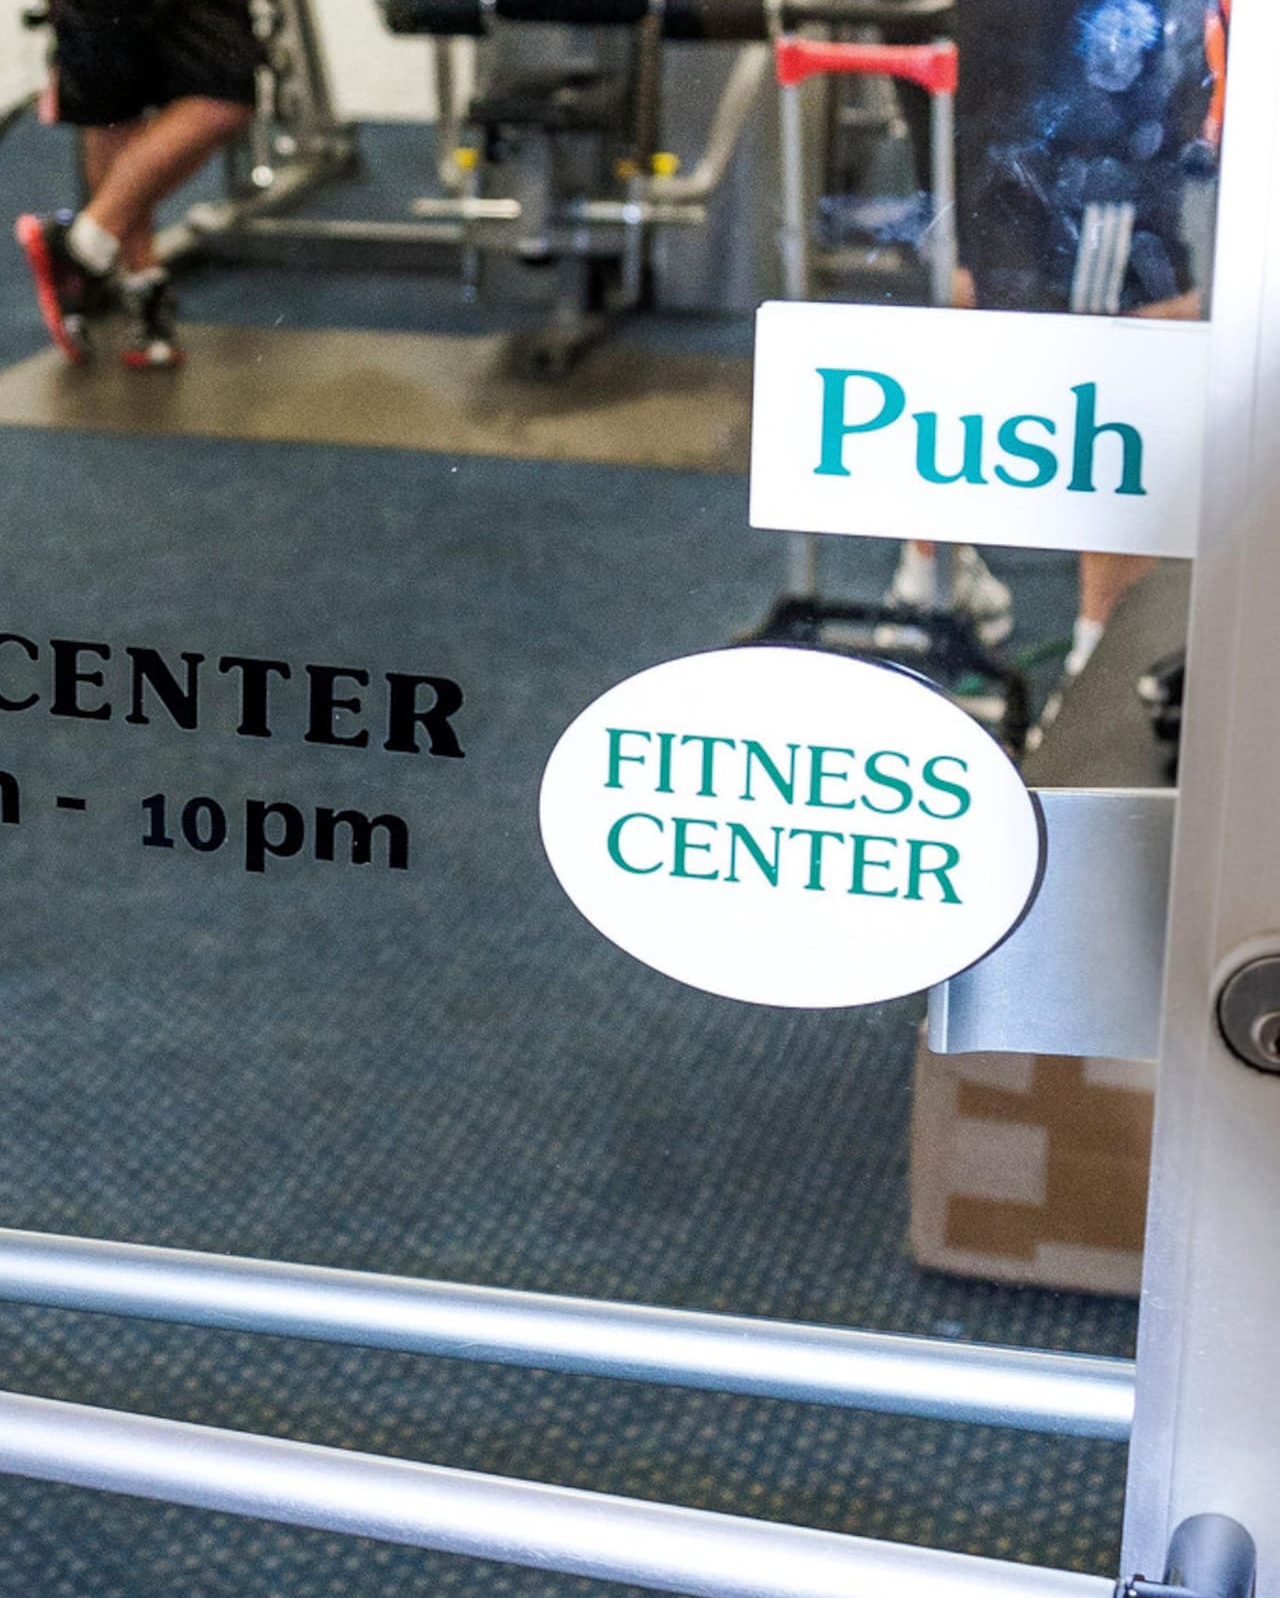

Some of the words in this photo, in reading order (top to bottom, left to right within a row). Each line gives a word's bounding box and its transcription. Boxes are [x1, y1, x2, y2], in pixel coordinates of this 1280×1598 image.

[813, 369, 1147, 495] Push
[604, 728, 972, 819] FITNESS
[607, 813, 964, 904] CENTER
